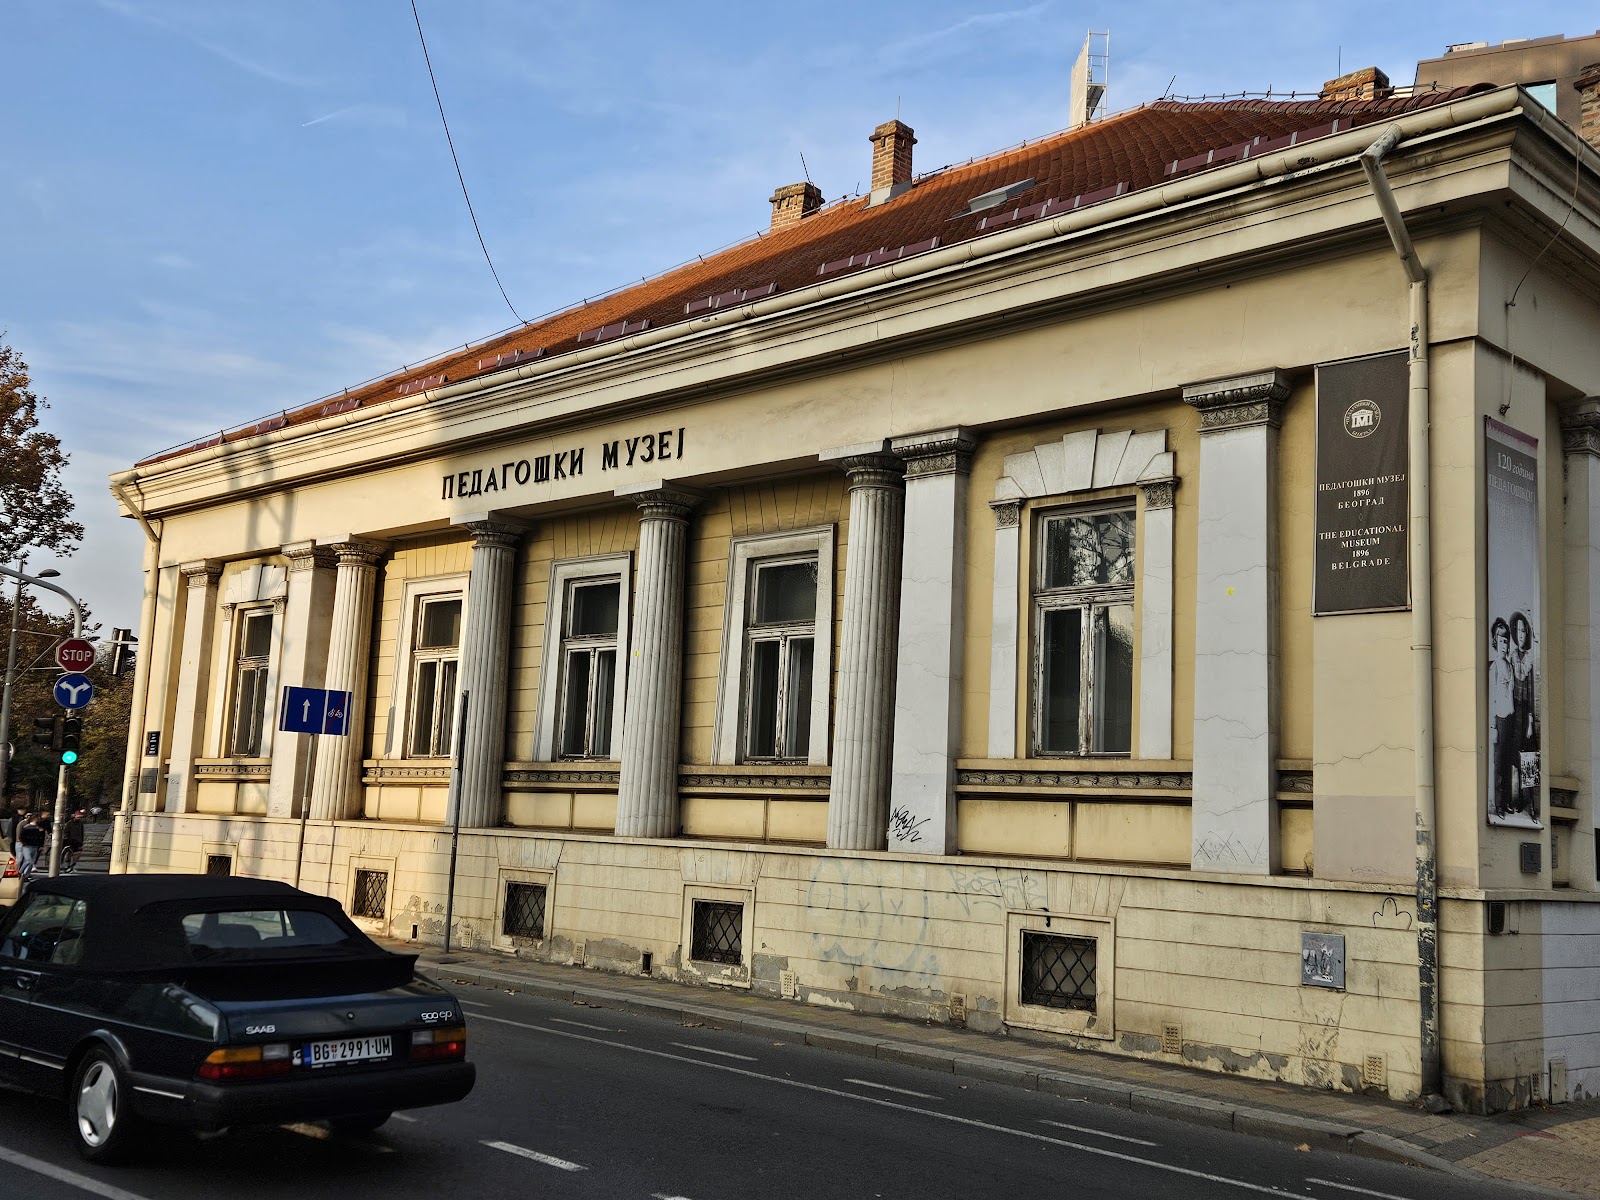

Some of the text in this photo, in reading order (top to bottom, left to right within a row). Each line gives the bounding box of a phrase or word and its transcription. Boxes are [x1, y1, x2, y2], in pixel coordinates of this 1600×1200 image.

[441, 427, 686, 500] ПЕДАГОШКИ МУЗЕЈ
[1498, 452, 1512, 471] 120
[1319, 474, 1405, 491] ПЕДАГОШКИ МУЗЕЈ
[1353, 489, 1370, 497] 1896
[1338, 496, 1385, 509] БЕОГРАД
[1319, 524, 1405, 540] THE EDUCATIONAL
[1341, 537, 1380, 548] MUSEUM
[1352, 549, 1370, 557] 1896
[1331, 557, 1391, 570] BELGRADE
[62, 649, 92, 662] STOP
[245, 1024, 276, 1035] SAAB
[313, 1043, 330, 1061] BG
